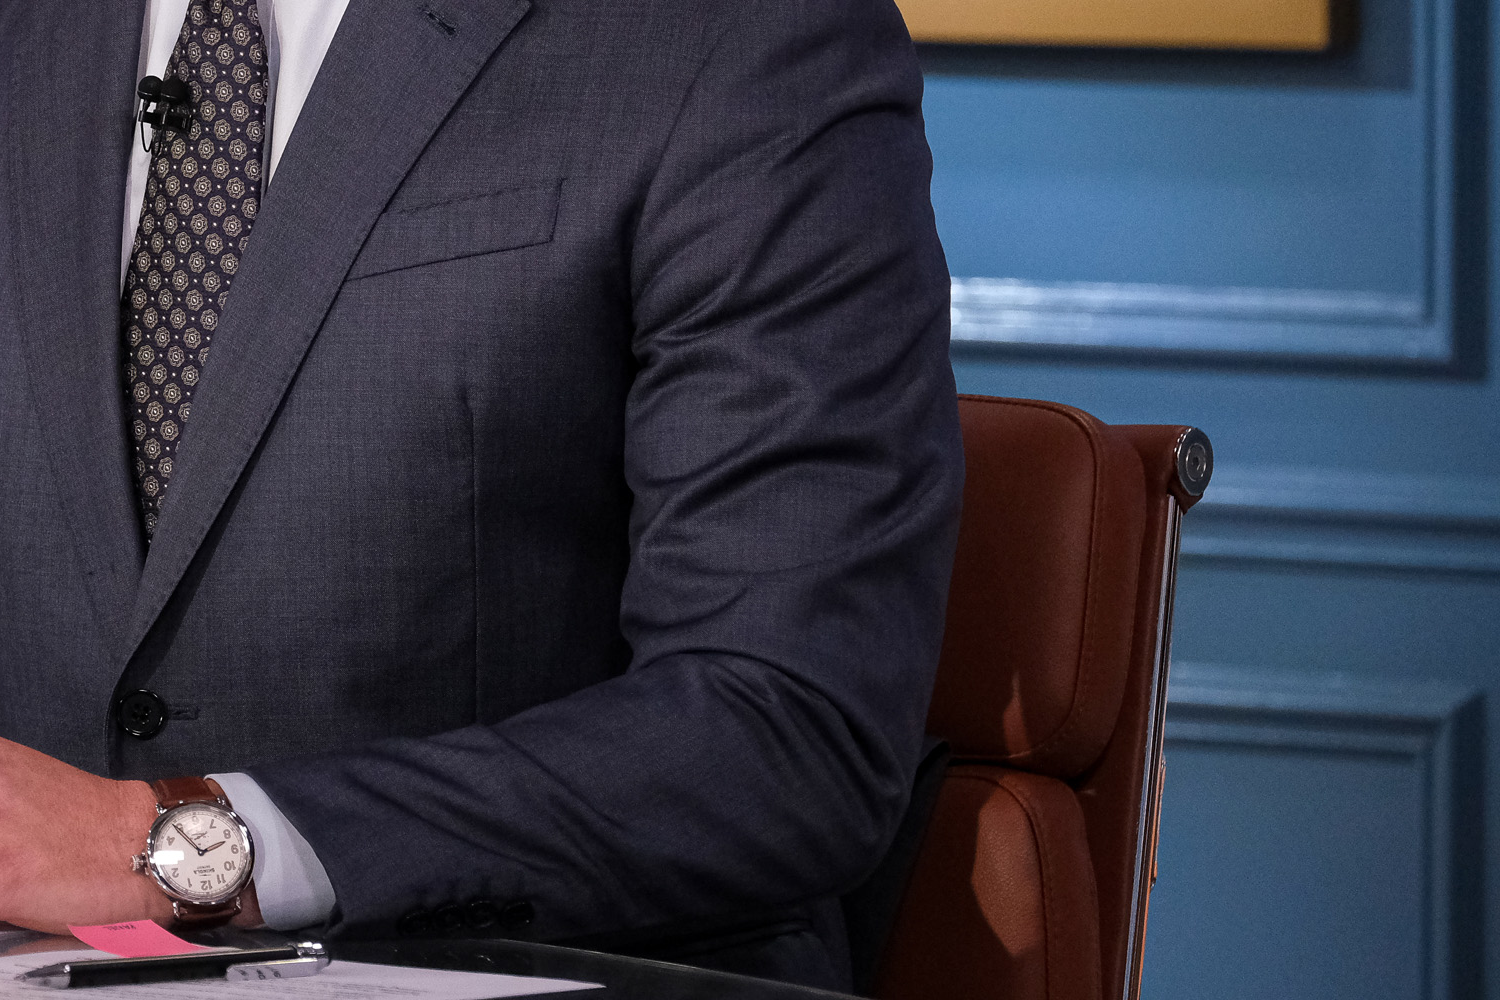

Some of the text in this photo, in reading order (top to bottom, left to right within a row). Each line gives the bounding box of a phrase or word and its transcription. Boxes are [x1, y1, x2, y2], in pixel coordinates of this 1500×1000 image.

[223, 829, 231, 839] 8
[231, 844, 239, 854] 9
[224, 860, 236, 872] 10
[171, 867, 180, 878] 2
[216, 874, 226, 884] 11
[200, 879, 213, 891] 12
